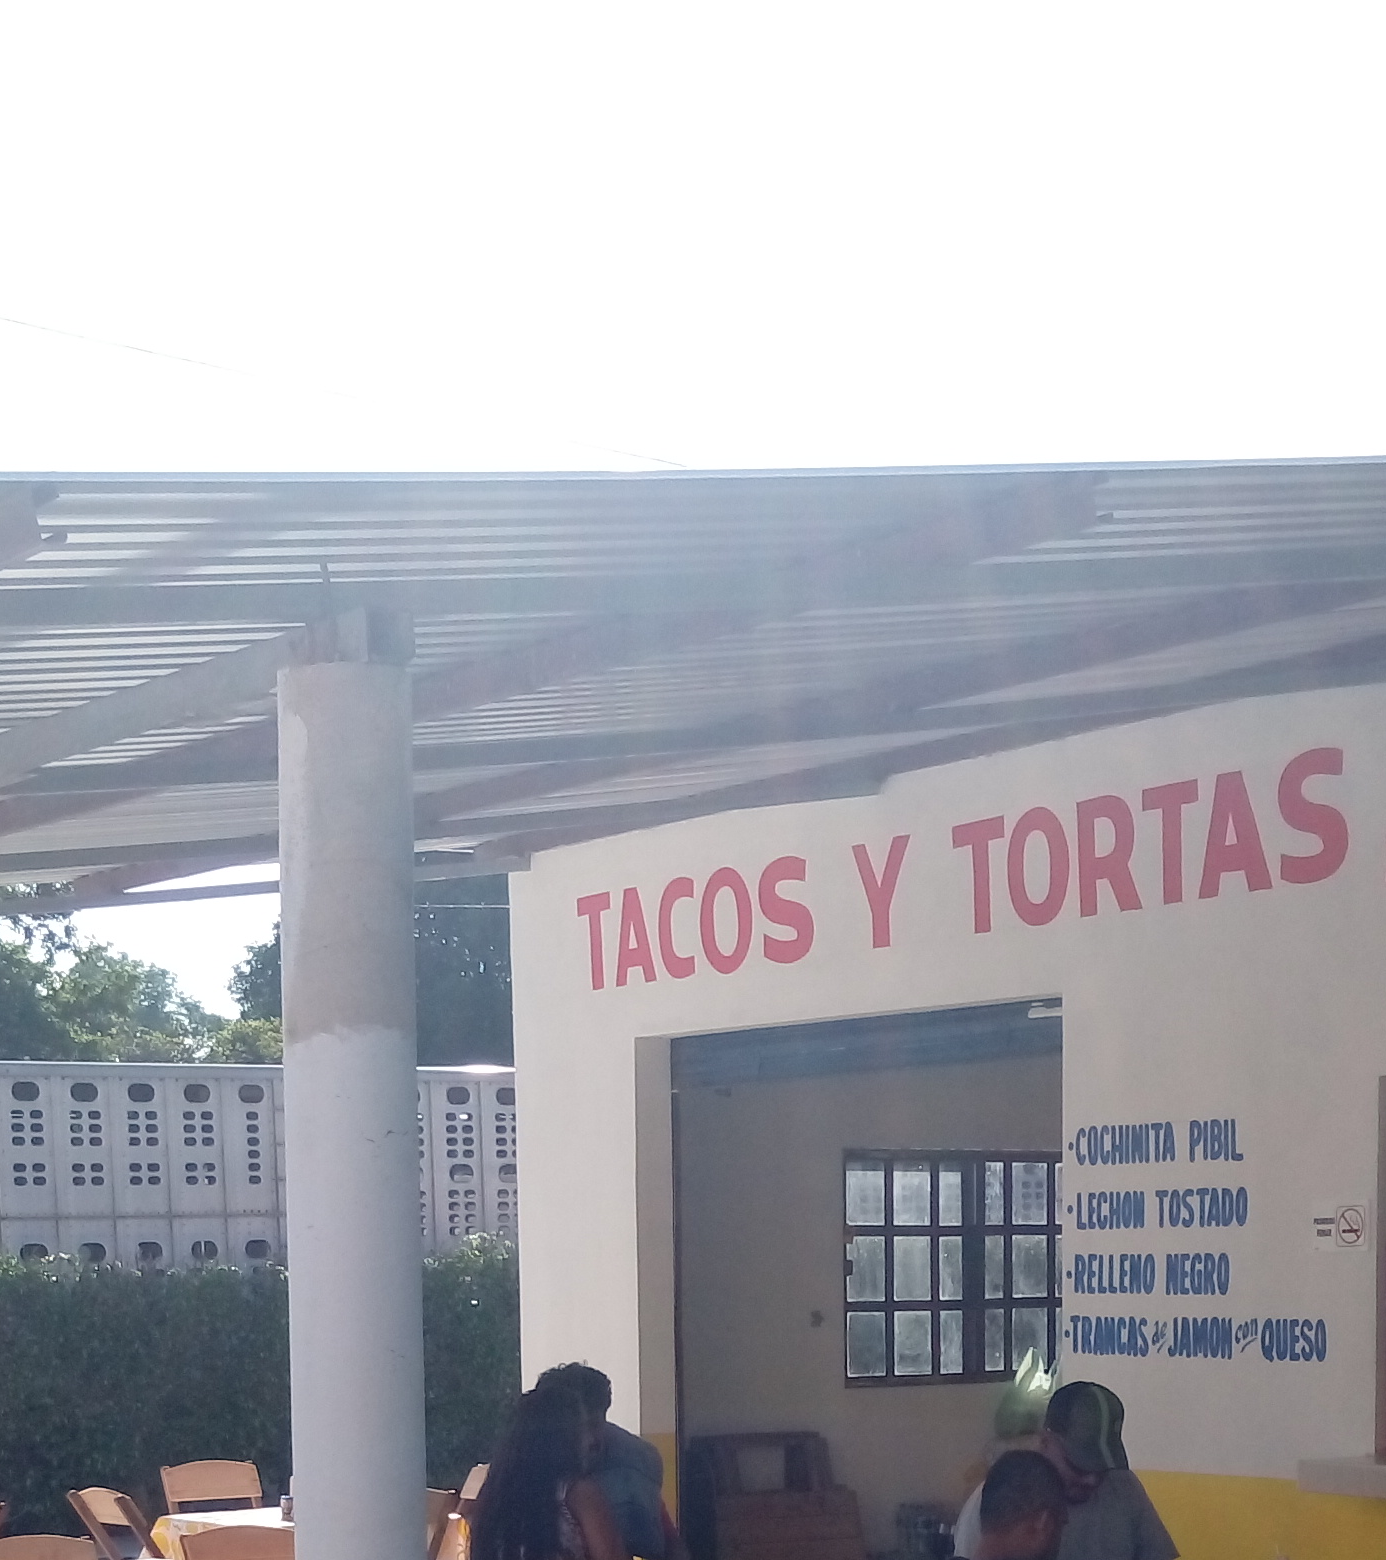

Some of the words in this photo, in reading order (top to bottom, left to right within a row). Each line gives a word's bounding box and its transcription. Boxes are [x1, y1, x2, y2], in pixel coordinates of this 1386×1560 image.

[576, 856, 814, 991] TACOS
[851, 835, 911, 949] Y
[952, 748, 1350, 934] TORTAS
[1075, 1121, 1176, 1166] COCHINITA
[1189, 1118, 1244, 1163] PIBIL
[1076, 1190, 1145, 1230] LECHON
[1155, 1186, 1248, 1228] TOSTADO
[1074, 1253, 1156, 1294] RELLENO
[1165, 1252, 1230, 1296] NEGRO
[1070, 1315, 1149, 1358] TRANCAS
[1152, 1320, 1168, 1346] de
[1167, 1316, 1233, 1360] JAMON
[1235, 1318, 1258, 1343] con
[1261, 1318, 1327, 1363] QUESO
